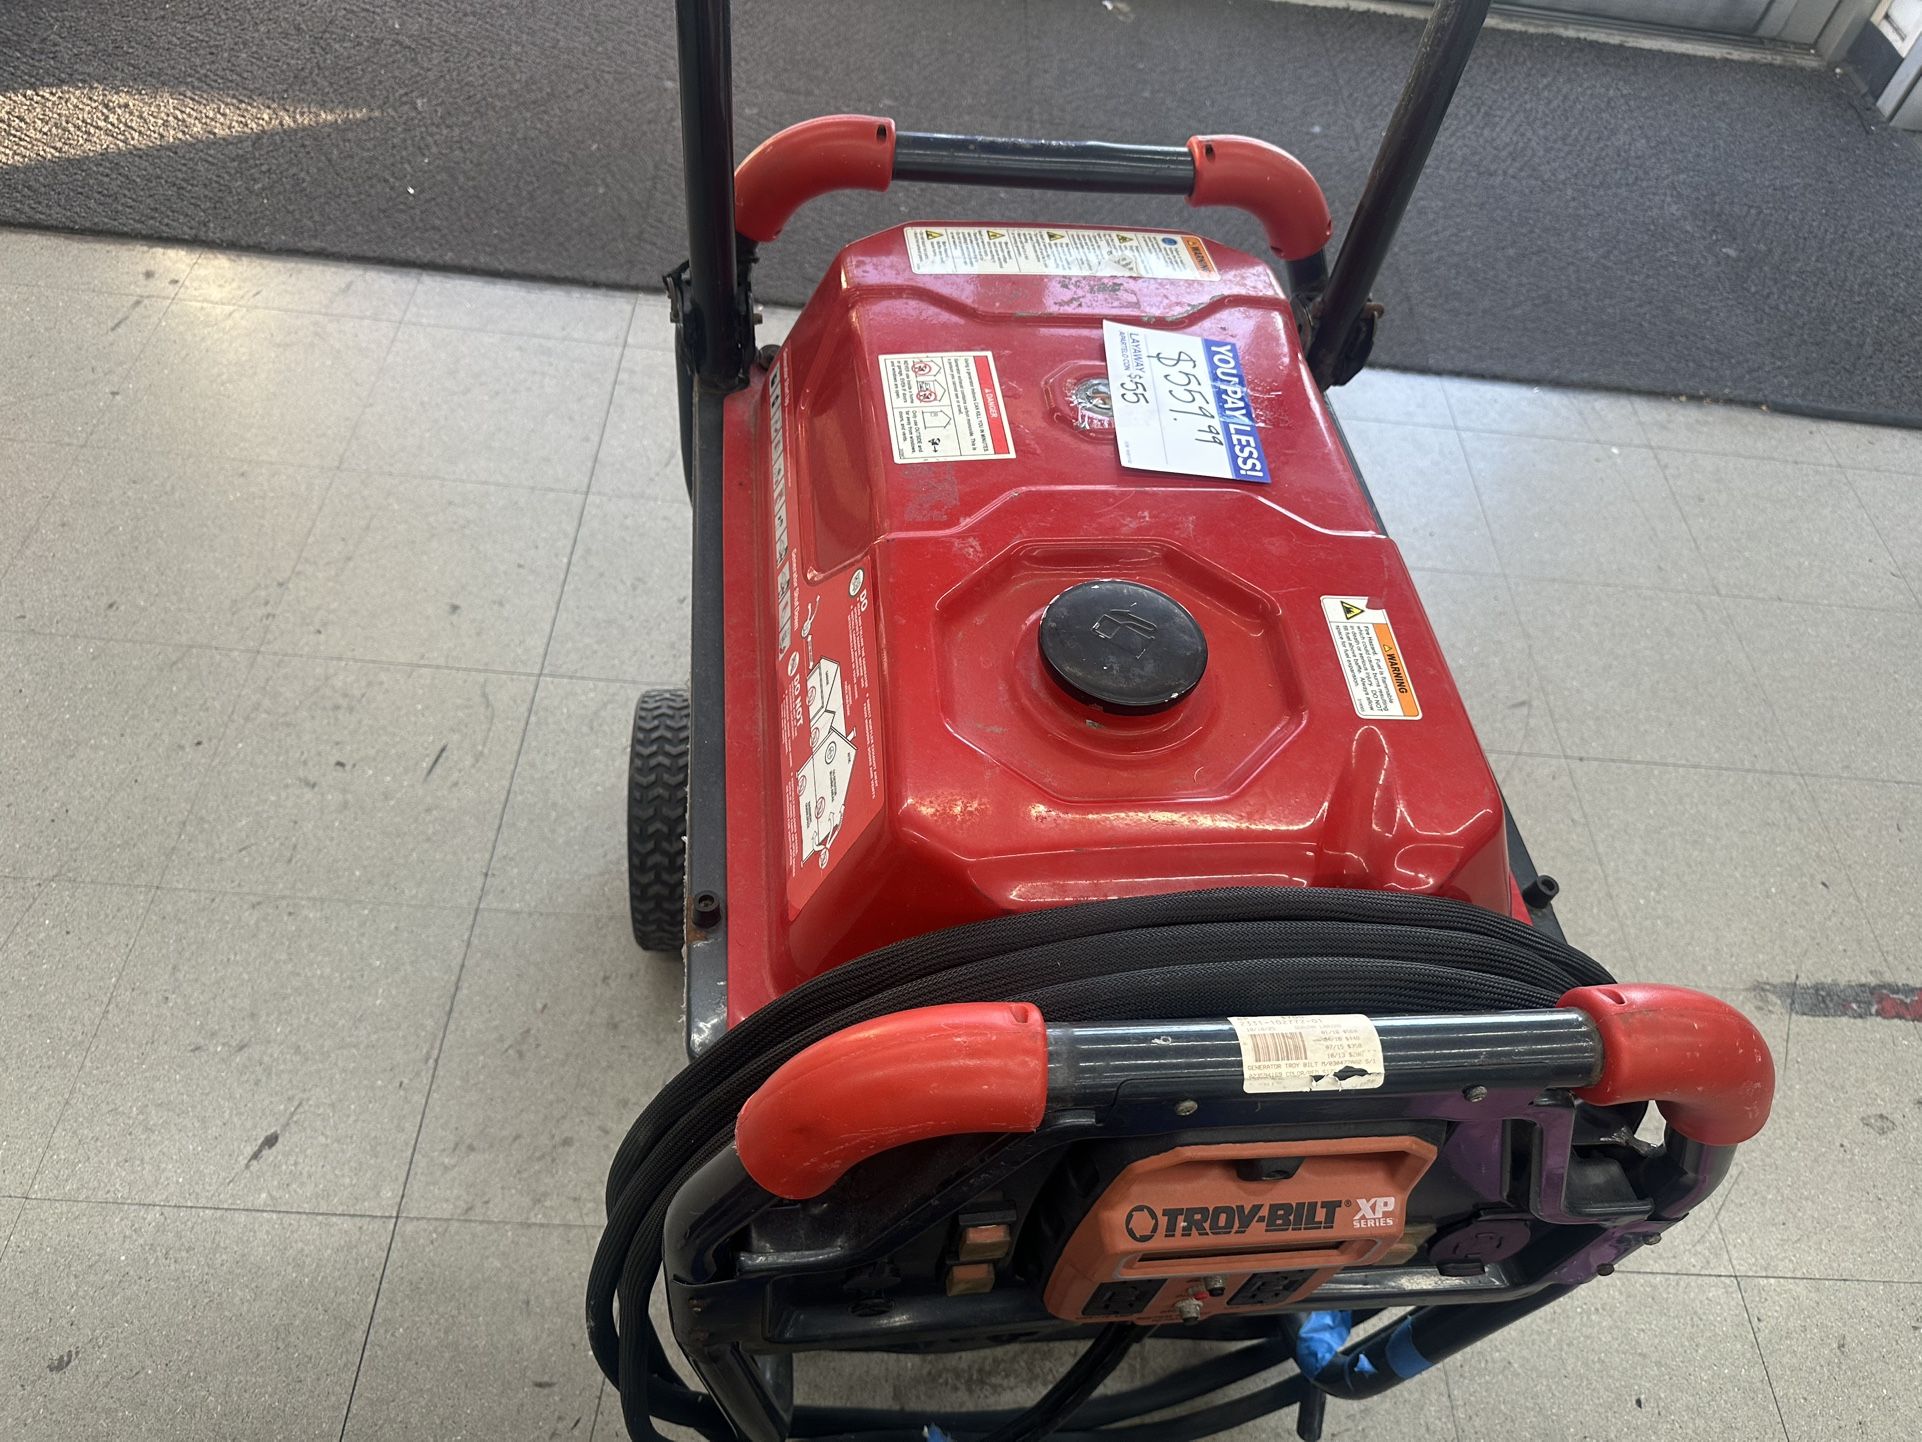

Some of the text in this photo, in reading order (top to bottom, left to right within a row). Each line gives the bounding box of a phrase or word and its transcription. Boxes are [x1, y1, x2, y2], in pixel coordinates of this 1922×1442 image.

[1129, 333, 1145, 373] LAYAWAY
[985, 393, 998, 417] DANGER
[1210, 345, 1263, 478] YOU PAY LESS!
[861, 588, 869, 611] DO
[1386, 653, 1407, 693] WARNING
[1162, 1196, 1395, 1238] TROY-BILT XP
[1352, 1217, 1394, 1229] SERIES
